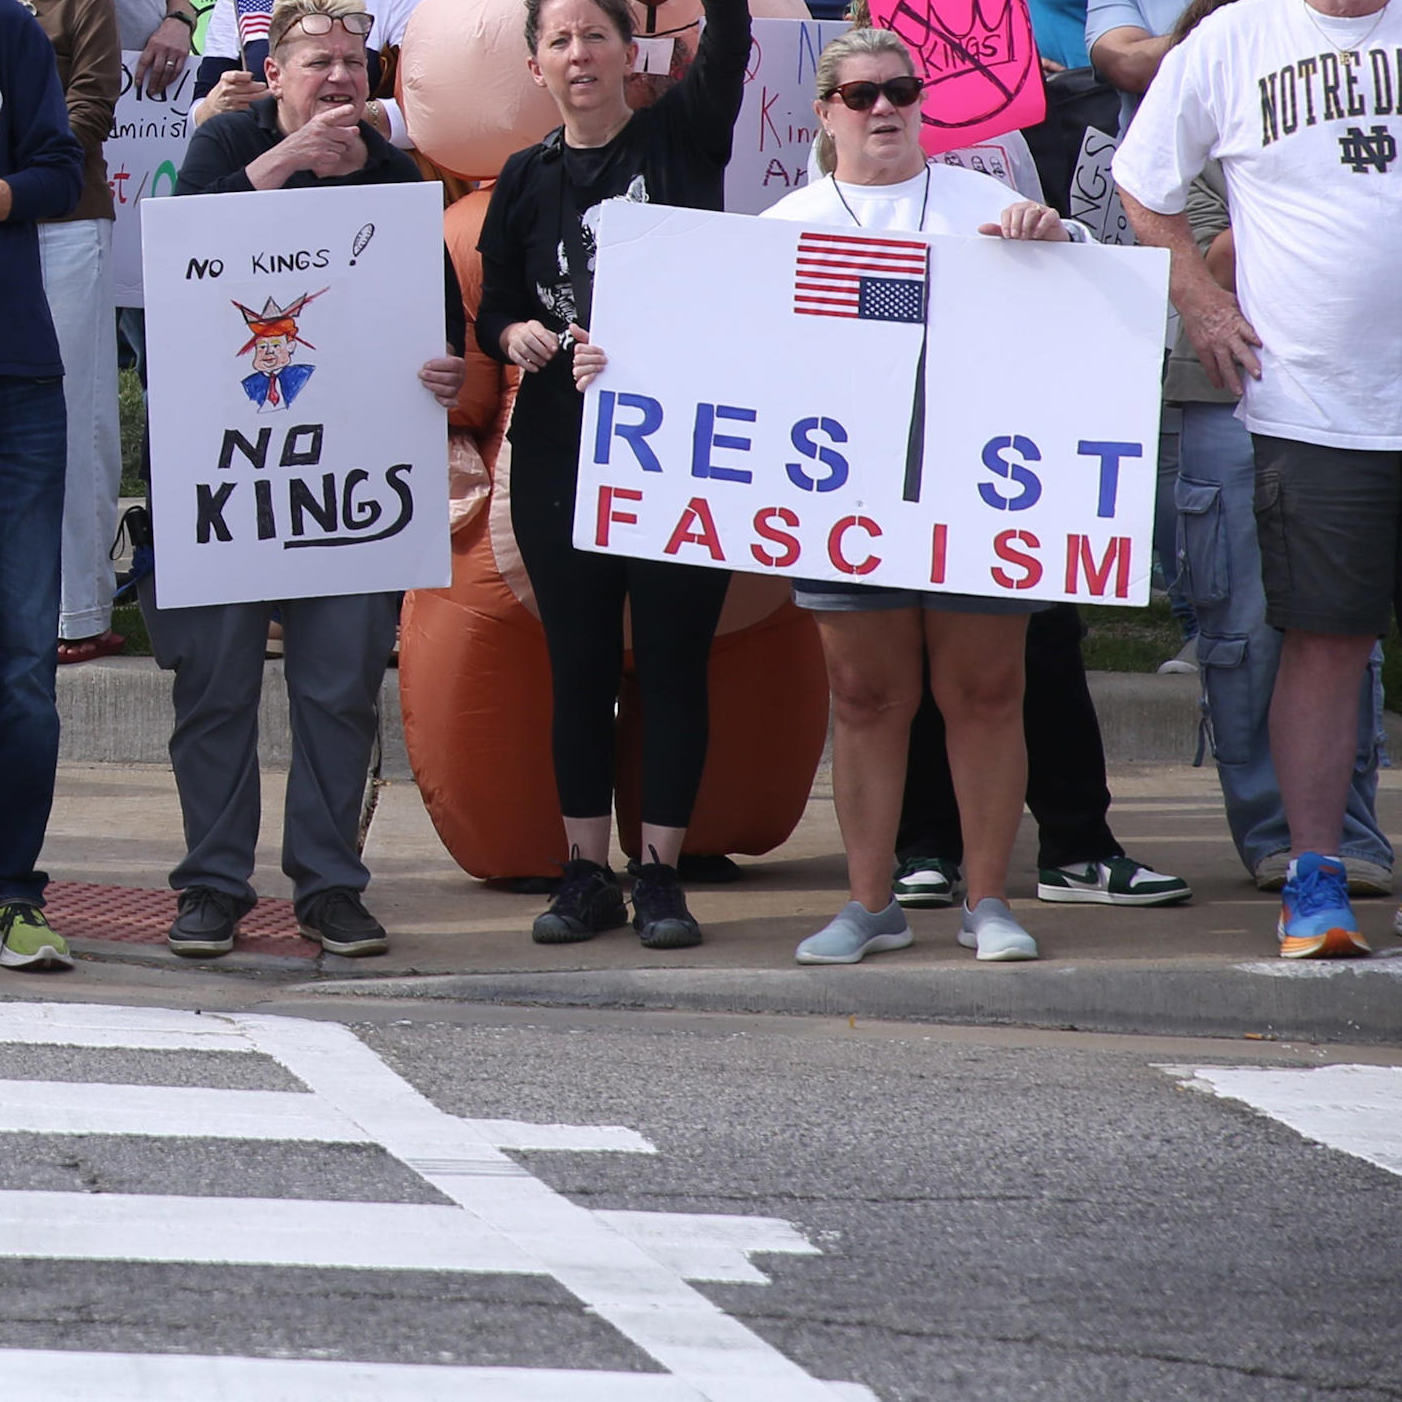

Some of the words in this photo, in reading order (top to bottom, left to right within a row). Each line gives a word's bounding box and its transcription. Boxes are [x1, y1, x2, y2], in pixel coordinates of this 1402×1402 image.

[918, 34, 1002, 79] KINGS
[108, 117, 188, 139] dminist
[759, 86, 818, 152] Kin
[1258, 50, 1366, 148] NOTRE
[186, 258, 224, 280] NO
[252, 249, 330, 274] KINGS
[218, 423, 324, 470] NO
[593, 389, 1143, 518] RESIST
[196, 464, 414, 549] KINGS
[595, 485, 1132, 599] FASCISM
